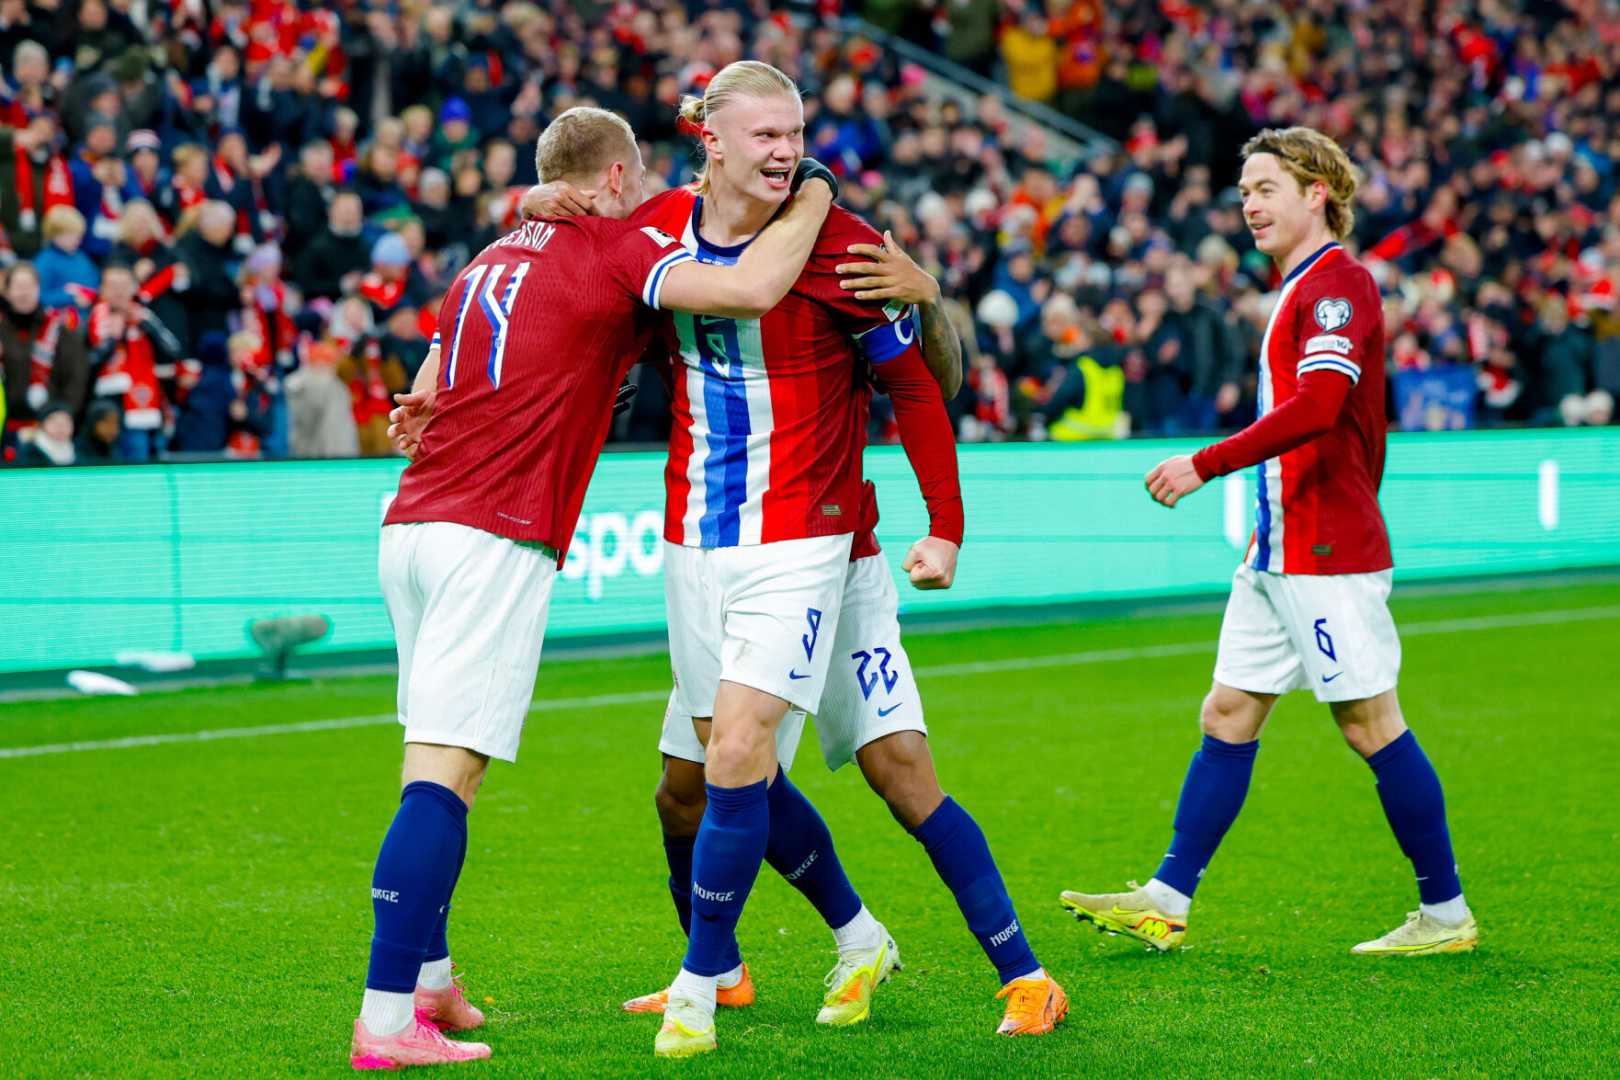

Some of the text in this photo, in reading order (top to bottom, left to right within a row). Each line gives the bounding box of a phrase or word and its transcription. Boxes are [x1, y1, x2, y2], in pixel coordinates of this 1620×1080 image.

[445, 261, 531, 391] 14
[894, 319, 914, 345] C
[706, 333, 730, 378] 9
[802, 607, 823, 664] 9
[1314, 617, 1338, 663] 6
[851, 647, 899, 702] 22
[371, 887, 400, 904] ORGE
[693, 880, 735, 902] NORGE
